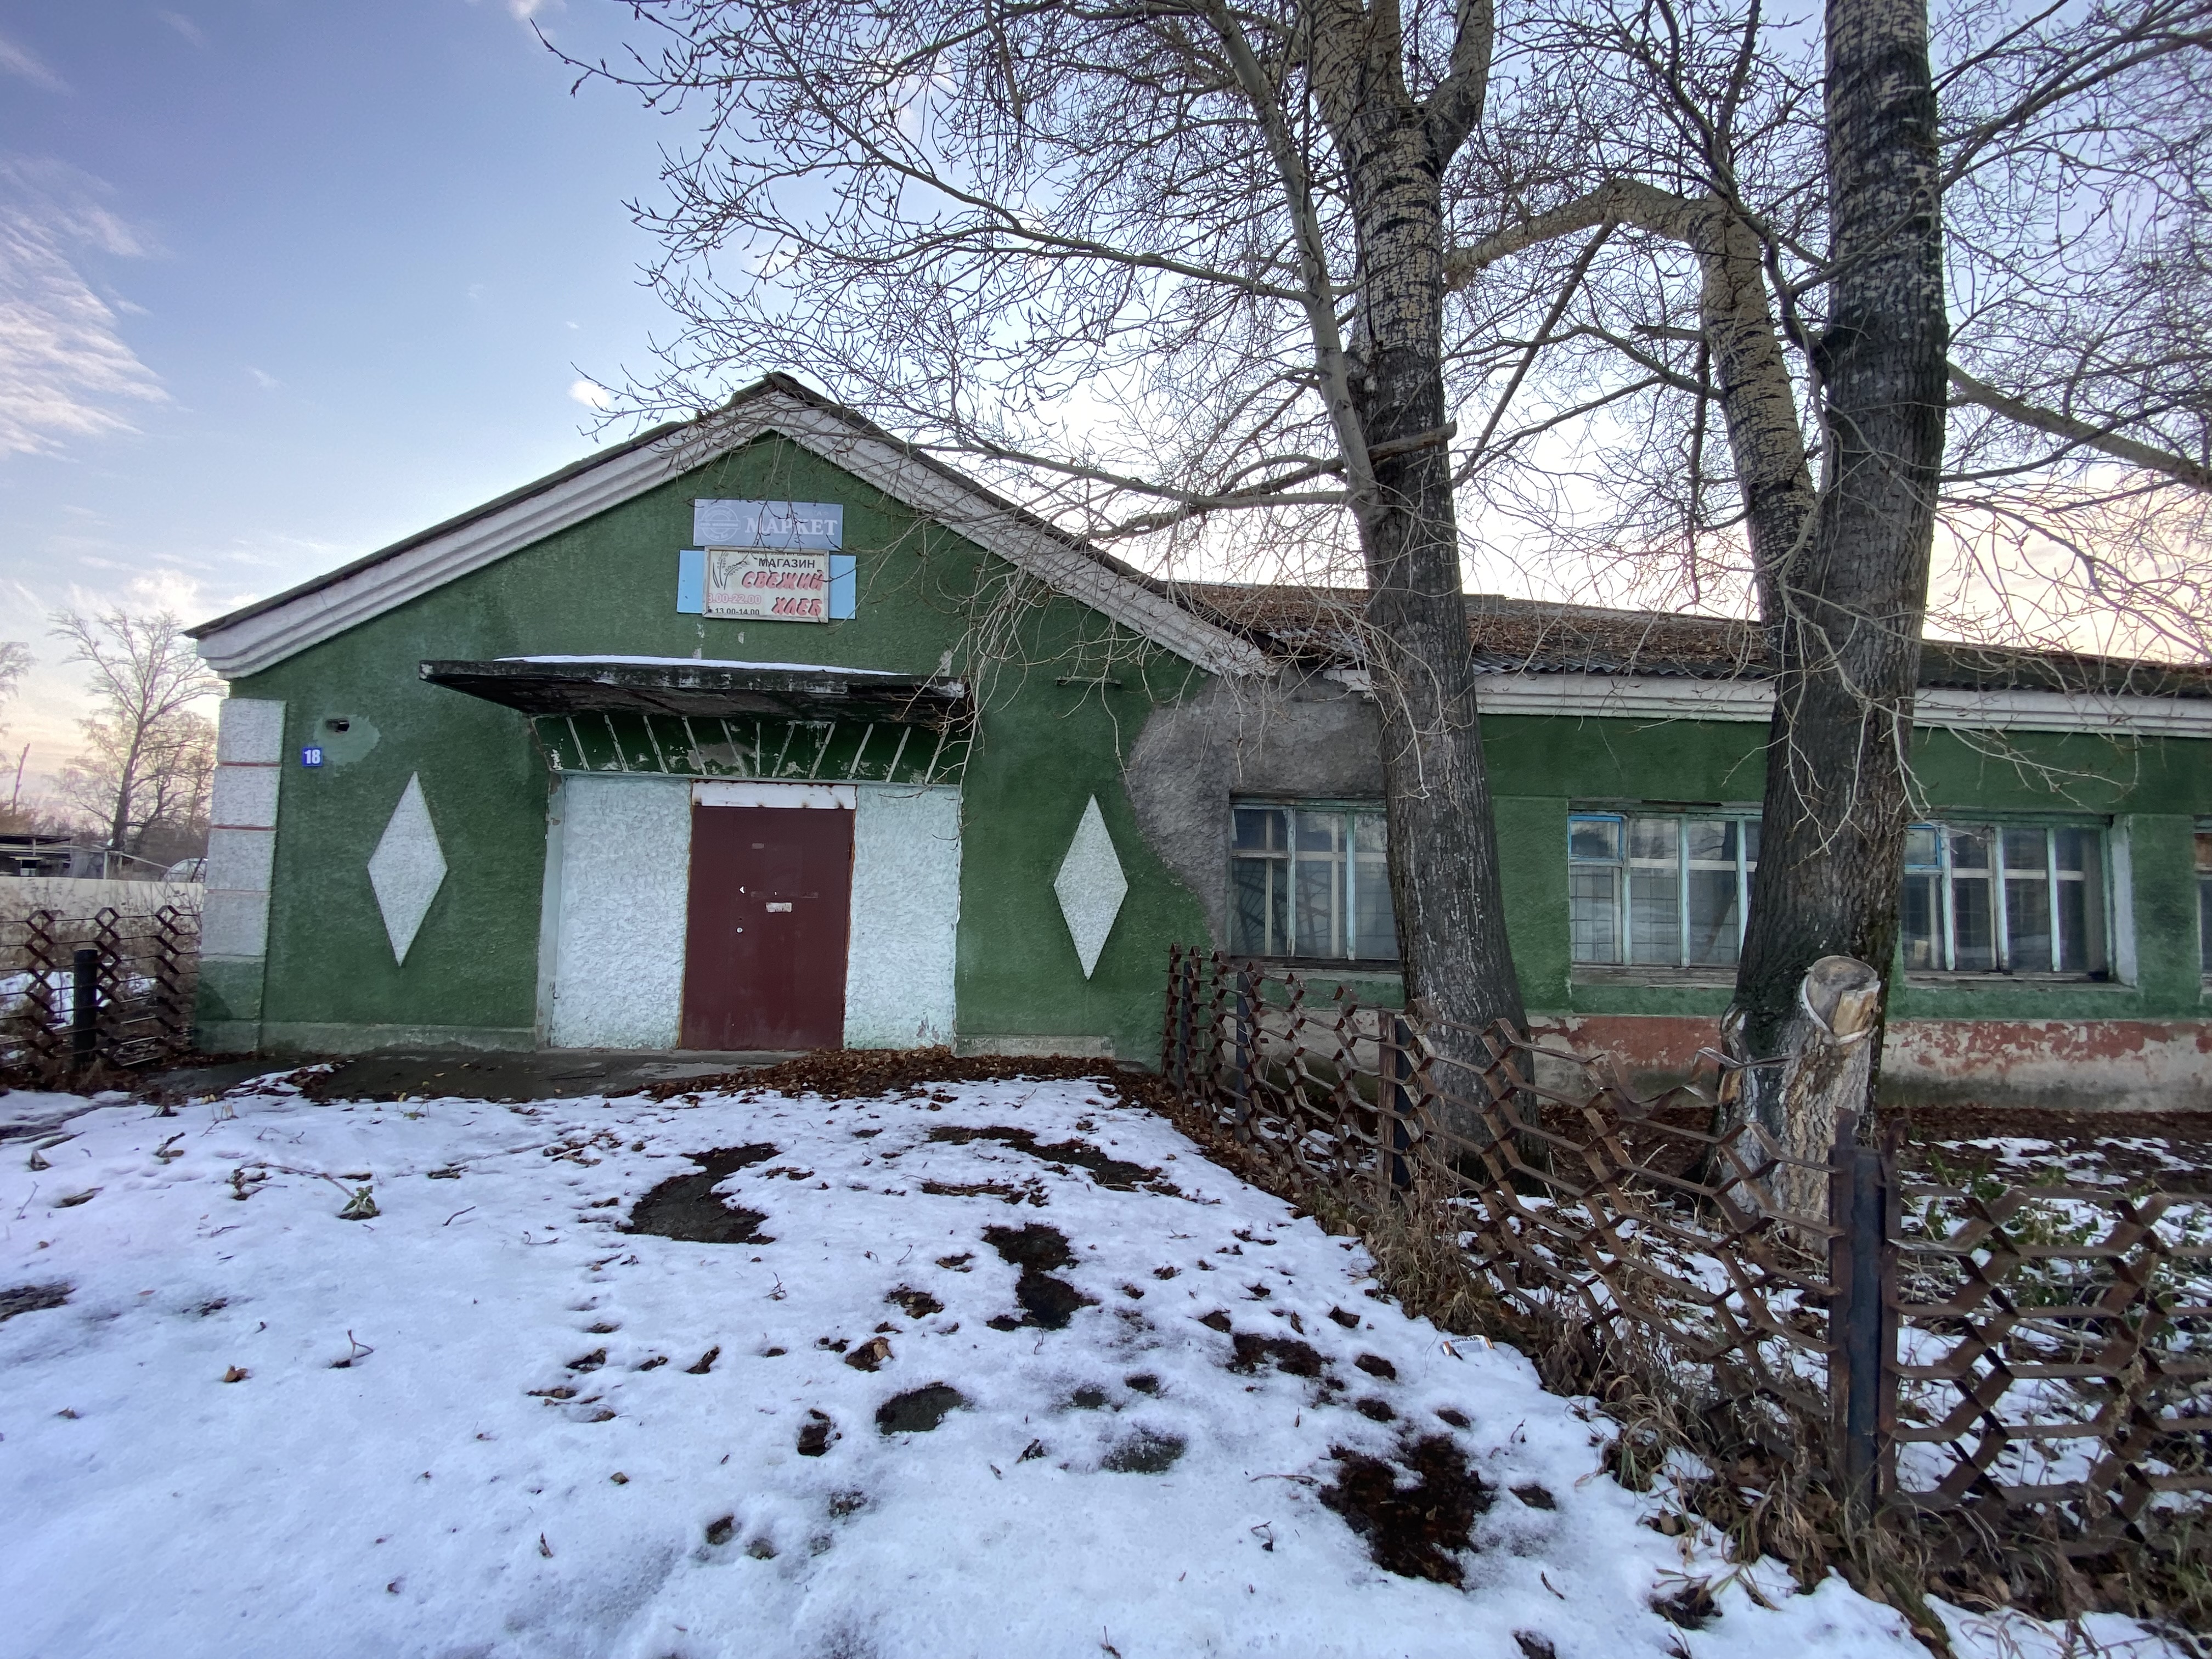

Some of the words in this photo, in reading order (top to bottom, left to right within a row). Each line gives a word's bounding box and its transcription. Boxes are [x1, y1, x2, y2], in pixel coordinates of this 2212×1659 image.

[744, 517, 838, 536] МАРКЕТ
[758, 557, 815, 568] МАГАЗИН
[742, 569, 824, 591] СВЕЖИЙ
[771, 596, 822, 616] ХЛЕБ
[304, 749, 320, 764] 18
